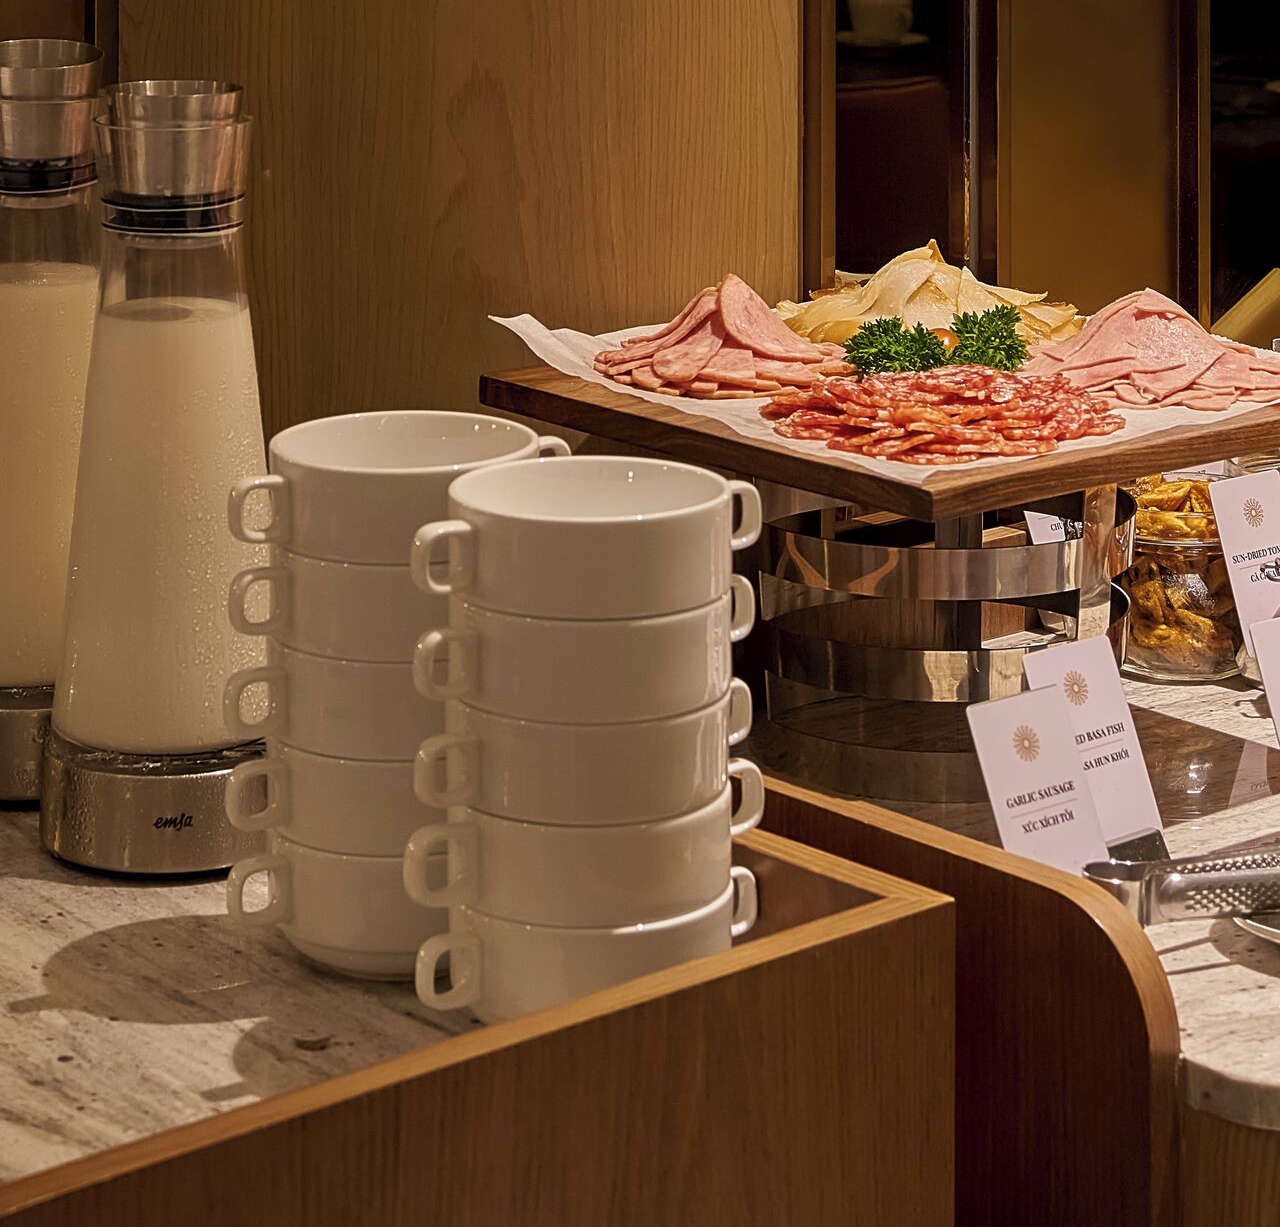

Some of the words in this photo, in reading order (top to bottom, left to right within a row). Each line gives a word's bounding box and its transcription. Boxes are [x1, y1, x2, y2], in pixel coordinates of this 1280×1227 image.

[1232, 548, 1268, 564] SUN-DRIED
[1251, 572, 1260, 583] CÀ
[1086, 728, 1107, 742] BASA
[1106, 722, 1125, 736] FISH
[1094, 754, 1111, 767] HUN
[1110, 747, 1130, 762] KHÓI
[1006, 791, 1038, 809] GARLIC
[1038, 780, 1075, 800] SAUSAGE
[153, 813, 193, 831] emsa
[1022, 820, 1039, 833] XÚC
[1039, 815, 1059, 829] XÍCH
